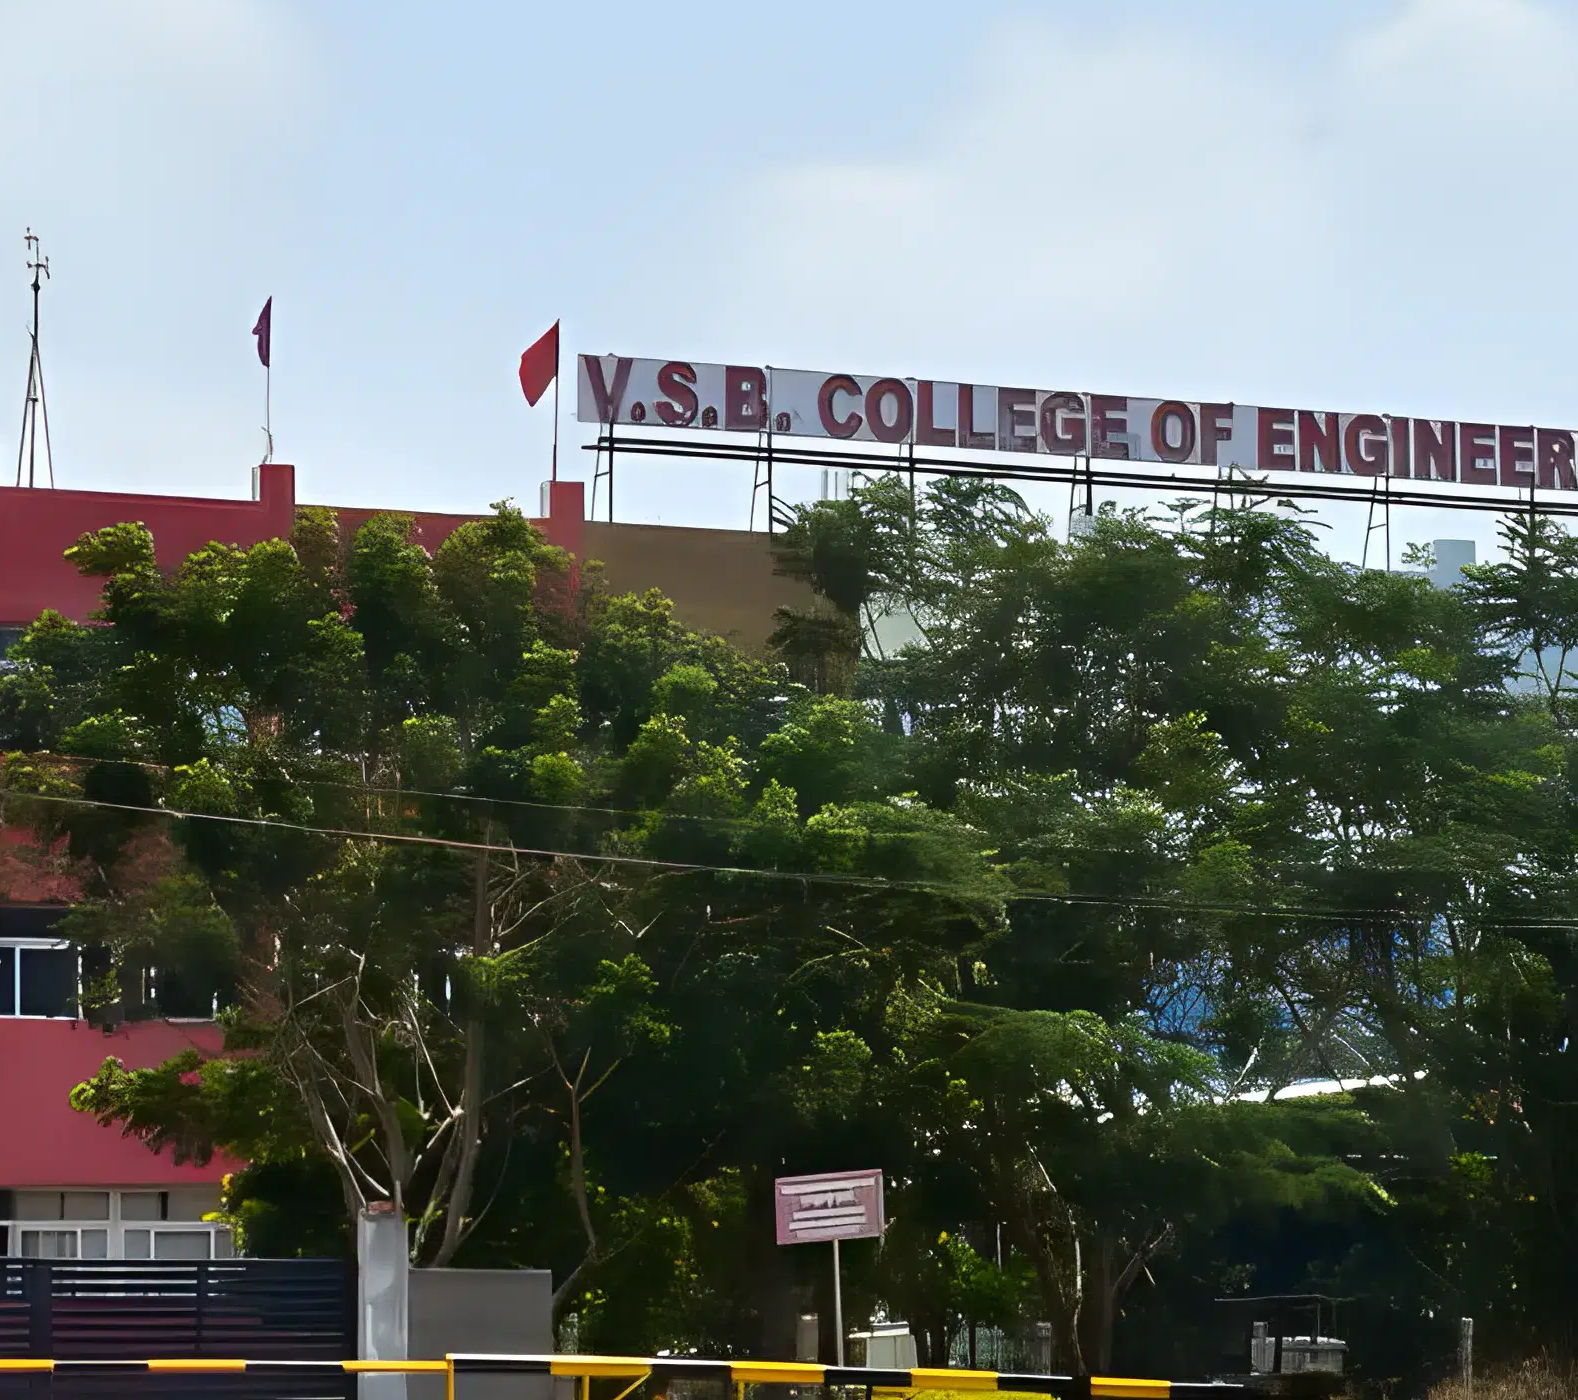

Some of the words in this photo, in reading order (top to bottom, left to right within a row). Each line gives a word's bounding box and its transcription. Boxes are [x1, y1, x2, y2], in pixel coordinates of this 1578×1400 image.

[584, 356, 791, 432] V.S.B.
[817, 374, 1139, 460] COLLEGE
[1151, 400, 1233, 466] OF
